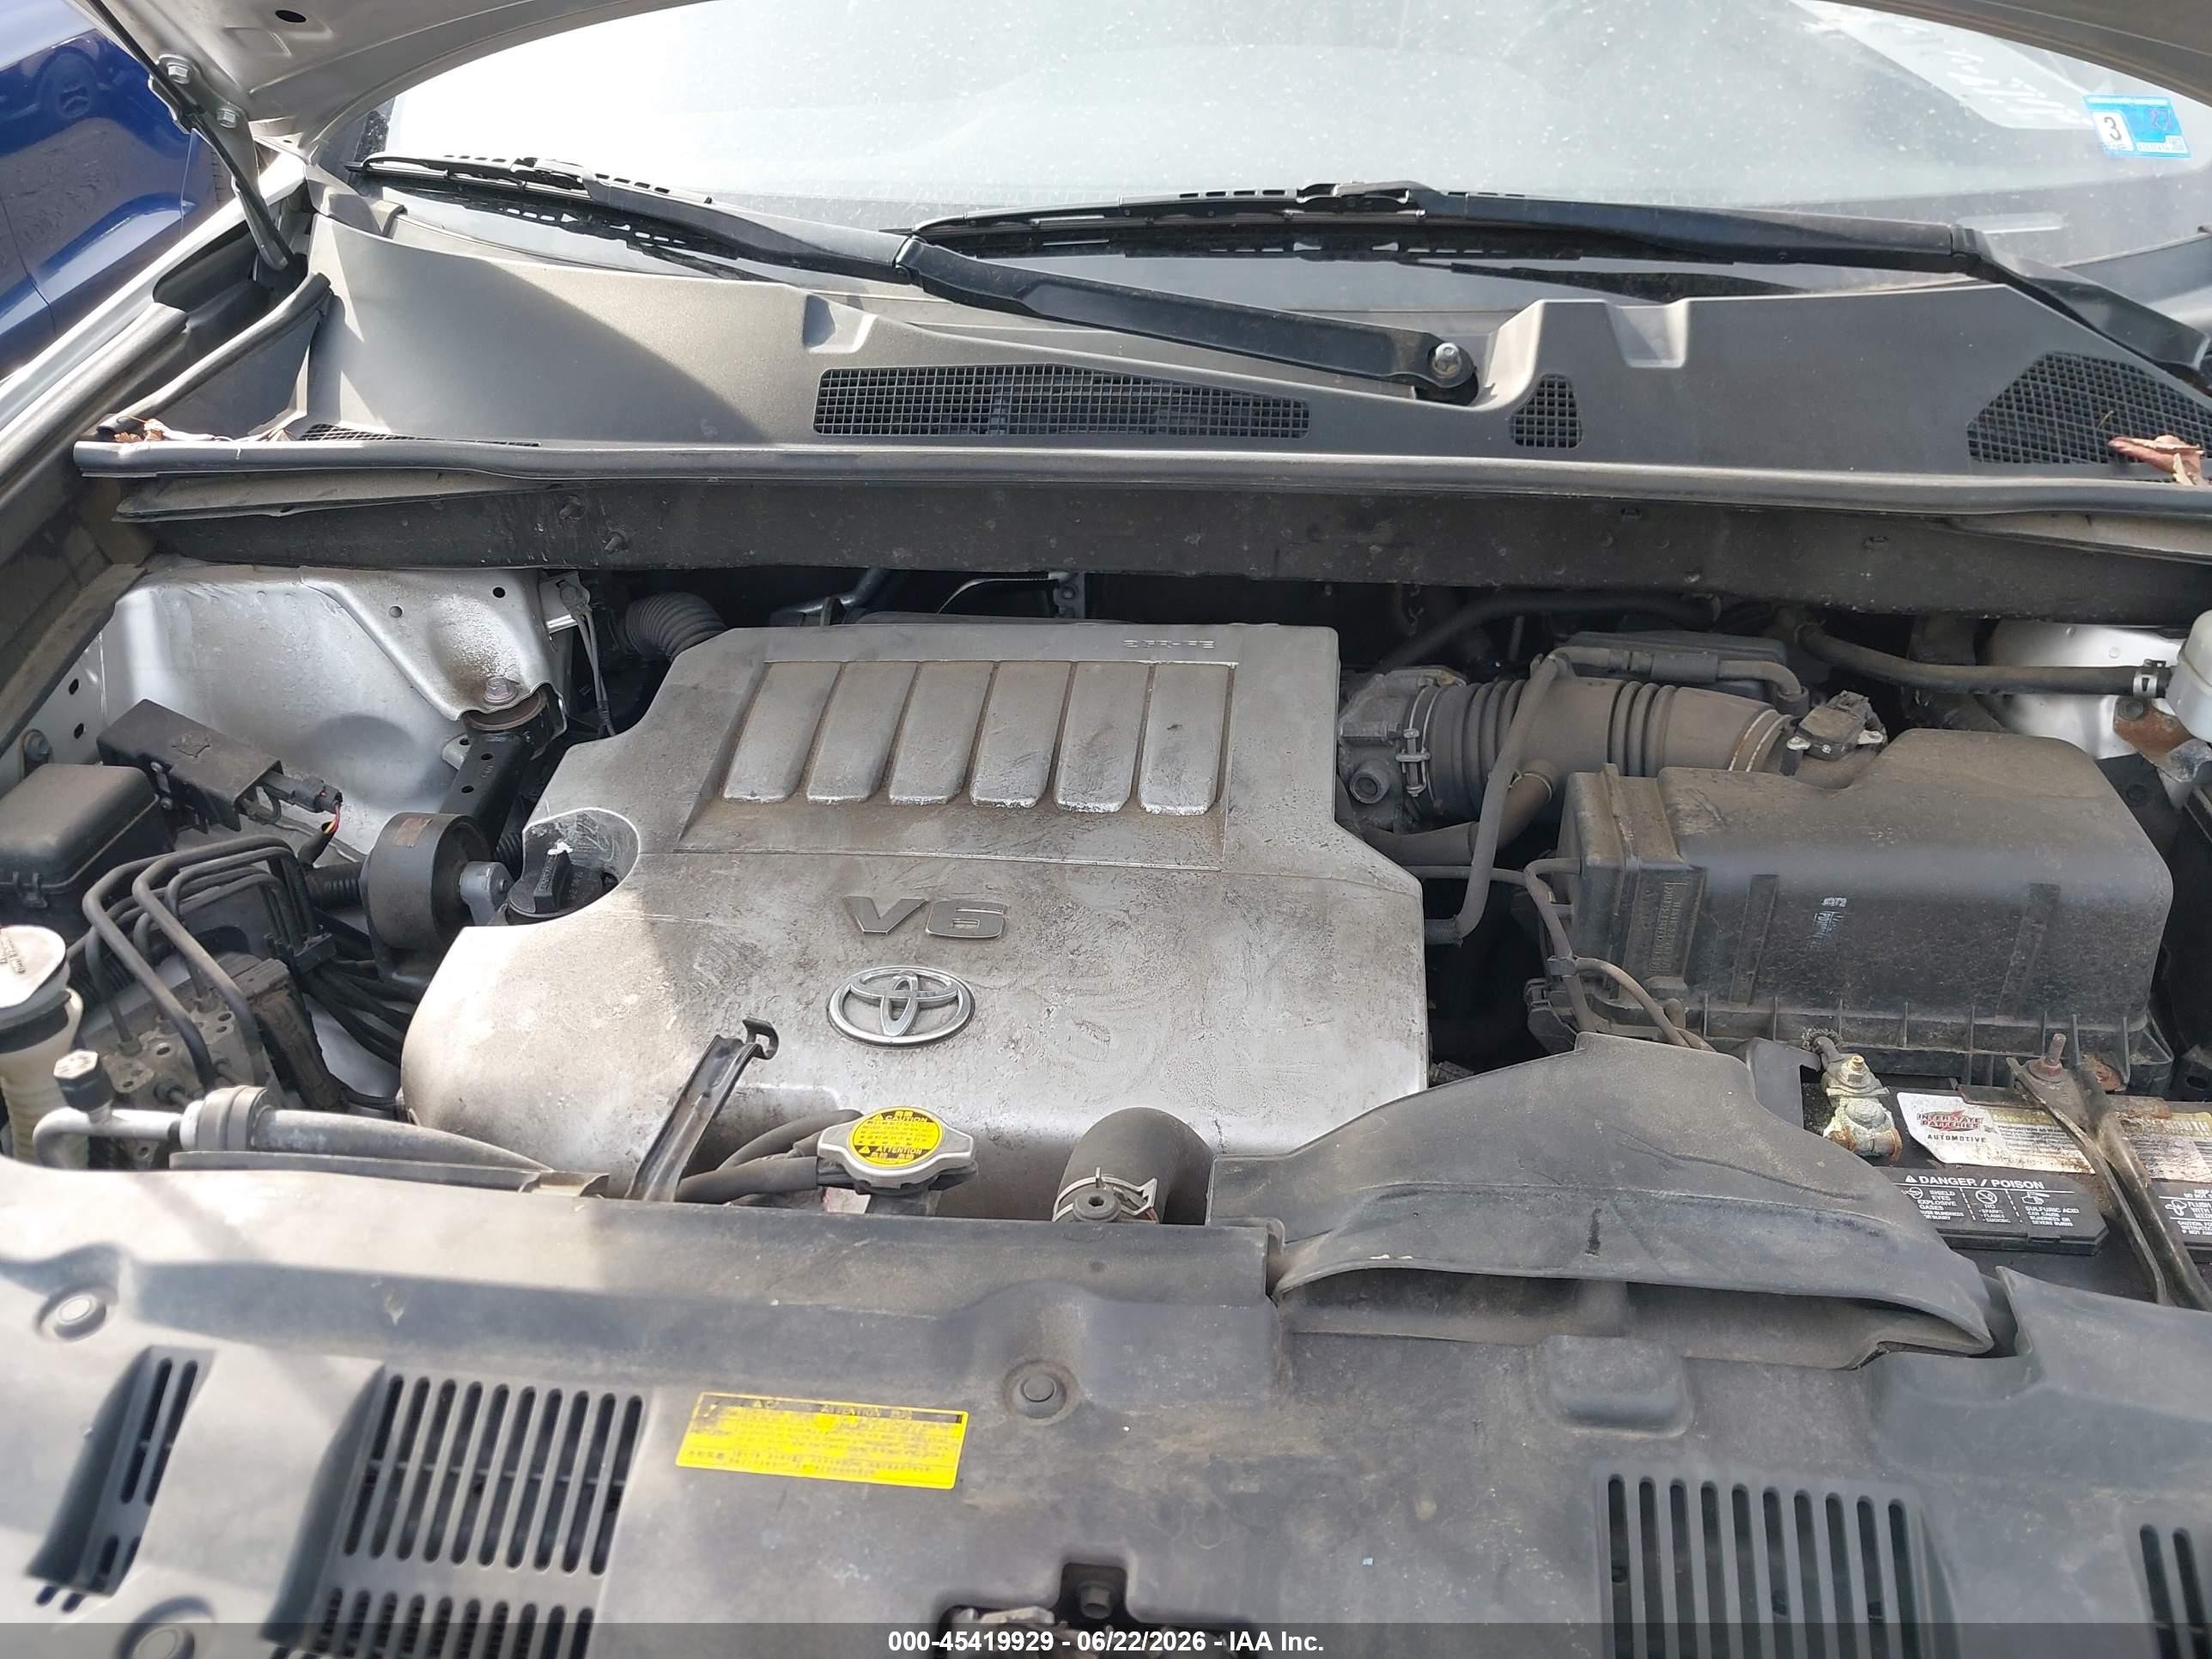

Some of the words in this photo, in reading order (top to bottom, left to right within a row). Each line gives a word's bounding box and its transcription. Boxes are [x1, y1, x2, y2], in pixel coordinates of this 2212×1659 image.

[2103, 115, 2123, 142] 3
[842, 895, 1008, 940] V6
[885, 1115, 928, 1123] CAUTION
[1917, 1113, 1984, 1124] INTERSTATE
[1921, 1120, 1980, 1129] BATTERIES
[1927, 1133, 1986, 1144] AUTOMOTIVE
[876, 1146, 922, 1155] ATTENTION
[1918, 1176, 1978, 1187] DANGER
[1990, 1179, 2045, 1190] POISON
